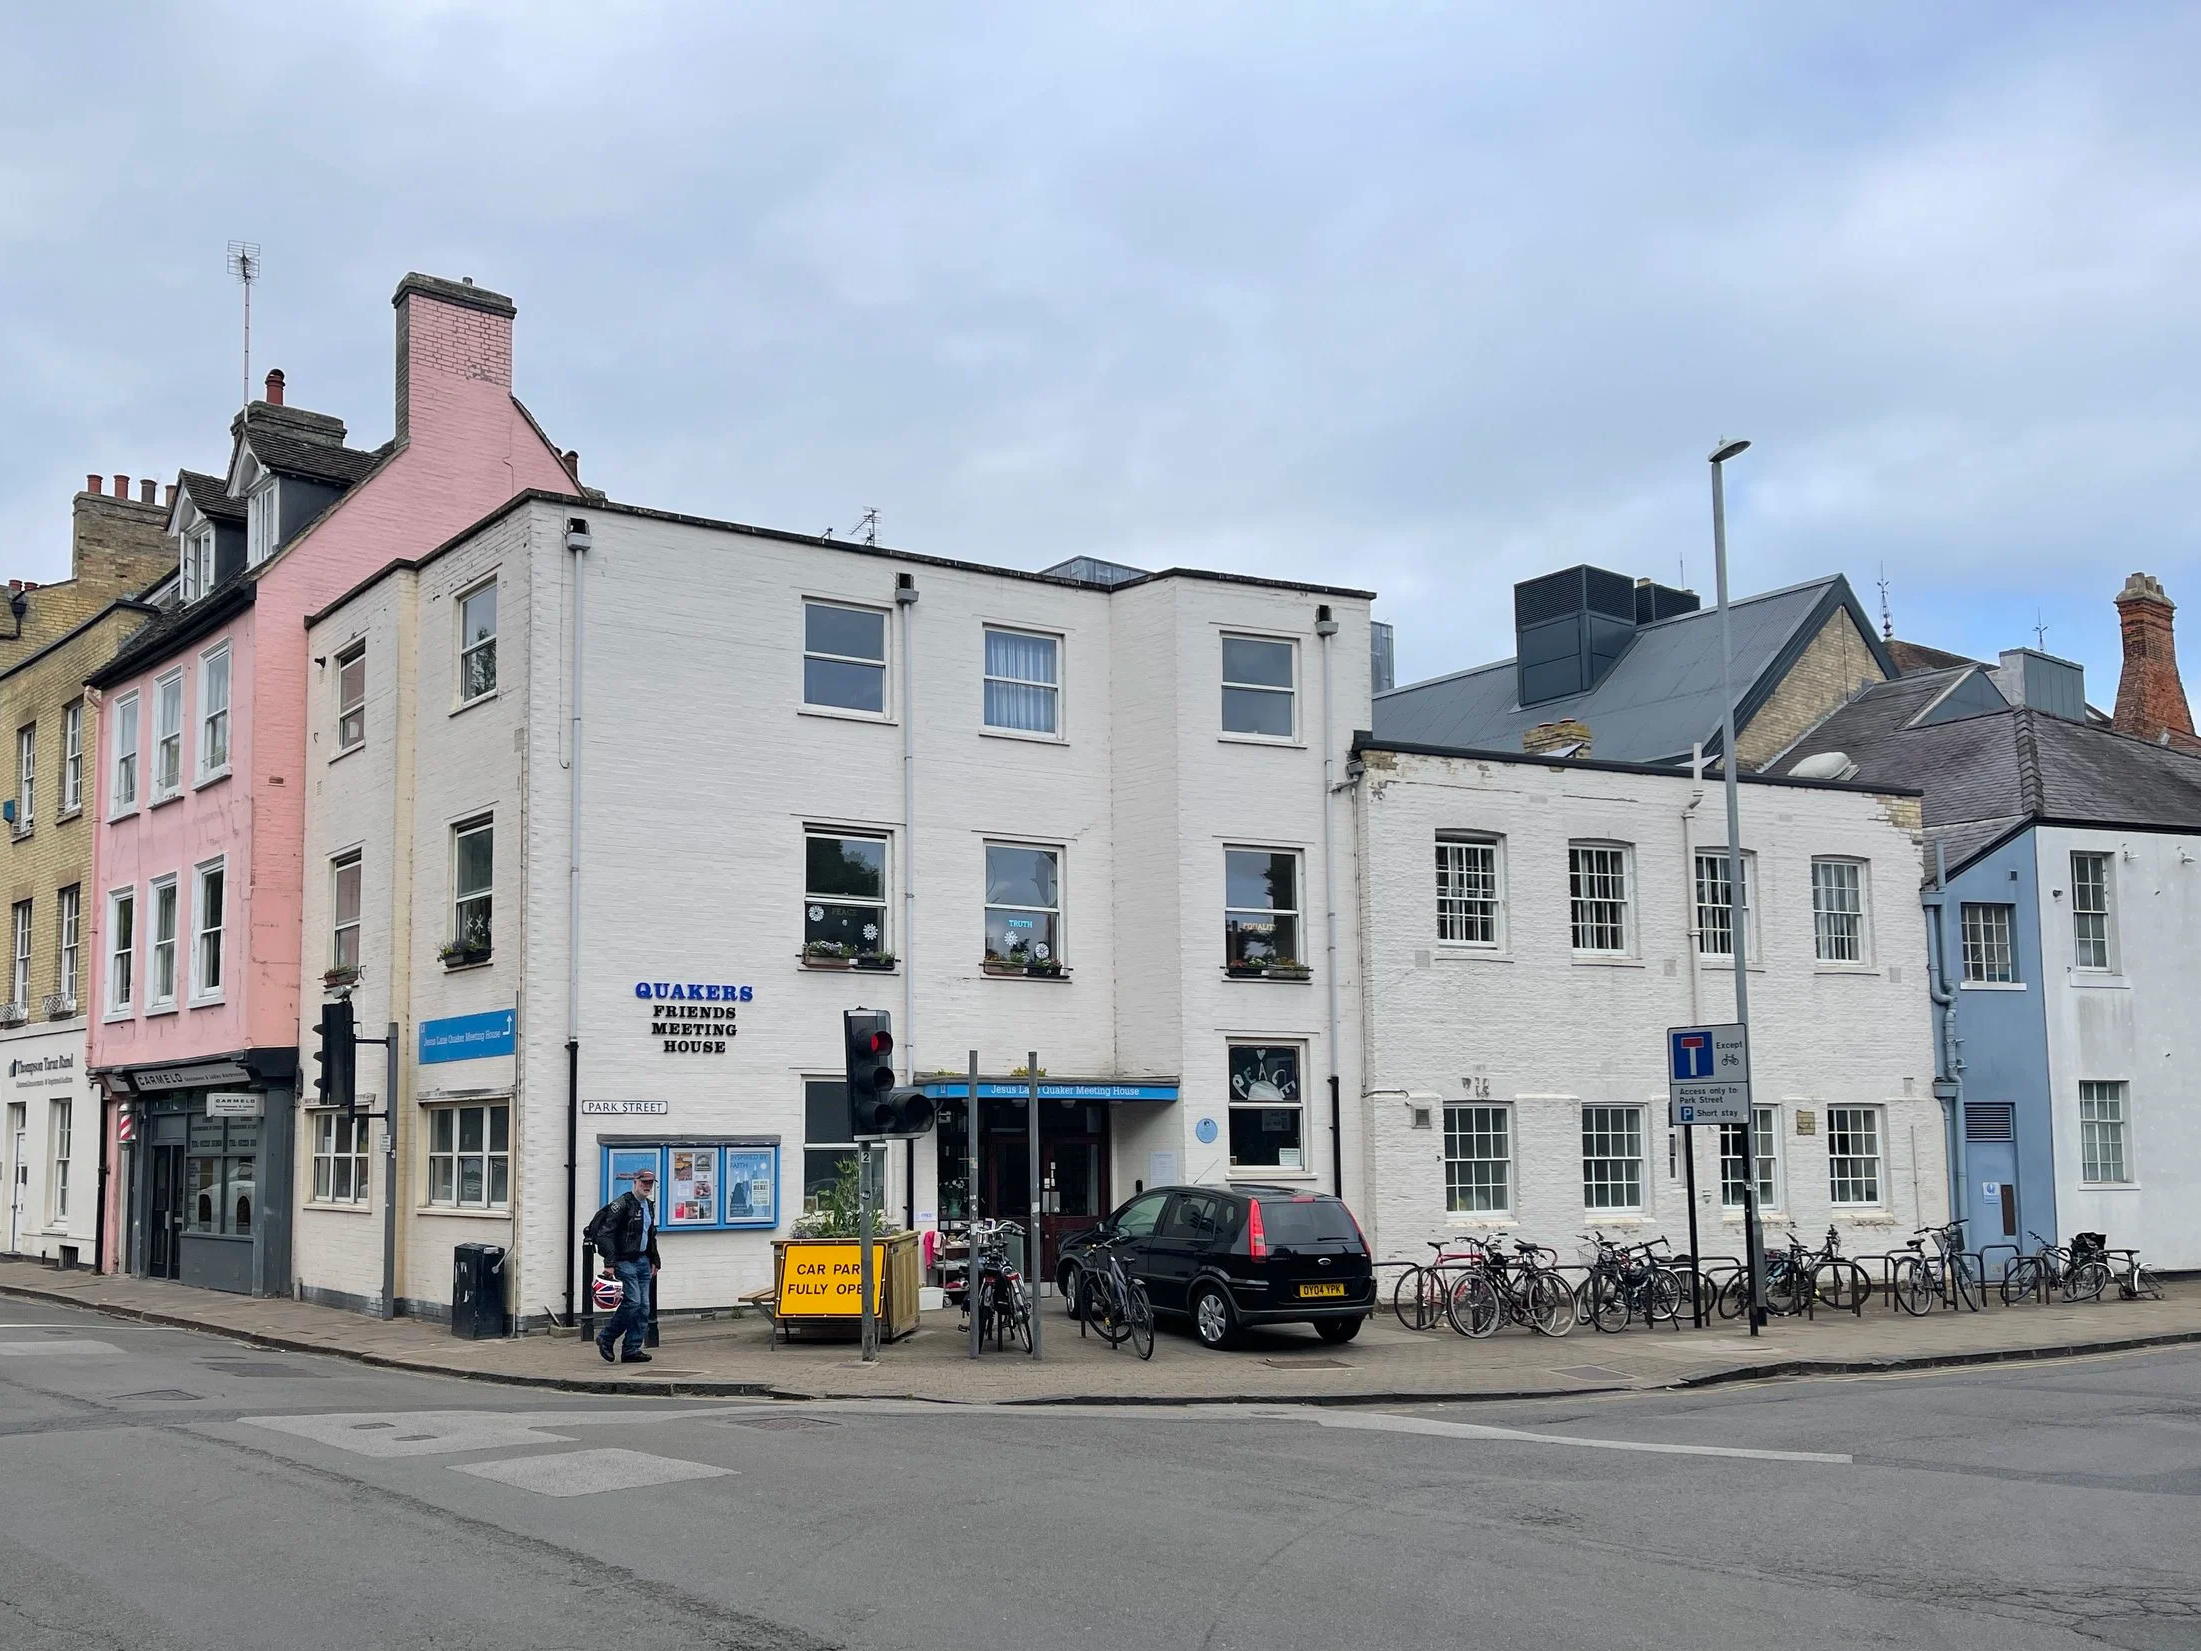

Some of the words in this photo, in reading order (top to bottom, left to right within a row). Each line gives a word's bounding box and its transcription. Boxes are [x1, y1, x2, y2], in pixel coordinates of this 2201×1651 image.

[832, 907, 857, 916] PEACE
[1009, 919, 1033, 928] TRUTH
[1243, 922, 1278, 931] EQUALITY
[635, 982, 753, 1001] QUAKERS
[653, 1005, 736, 1018] FRIENDS
[652, 1022, 737, 1036] MEETING
[424, 1037, 436, 1047] Jesus
[436, 1036, 447, 1045] Lane
[448, 1034, 465, 1044] Quaker
[465, 1032, 485, 1042] Meeting
[485, 1030, 500, 1039] House
[663, 1040, 726, 1053] HOUSE
[1716, 1041, 1743, 1049] Except
[137, 1073, 183, 1086] CARMELO
[1232, 1061, 1296, 1098] PEACE
[990, 1084, 1016, 1094] Jesus
[1018, 1085, 1040, 1094] Lae
[1042, 1085, 1073, 1095] Quaker
[1075, 1086, 1111, 1097] Meeting
[1113, 1086, 1140, 1096] House
[1680, 1087, 1706, 1095] Access
[1710, 1087, 1726, 1095] only
[588, 1102, 618, 1112] PARK
[622, 1102, 663, 1113] STREET
[1683, 1108, 1692, 1120] P
[1697, 1109, 1717, 1117] Short
[1721, 1109, 1738, 1117] stay
[863, 1152, 869, 1161] 2
[797, 1264, 826, 1275] CAR
[833, 1264, 860, 1275] PAR
[787, 1284, 828, 1295] FULLY
[836, 1284, 874, 1295] OPE
[1303, 1285, 1324, 1295] OY04
[1326, 1284, 1341, 1294] YPK
